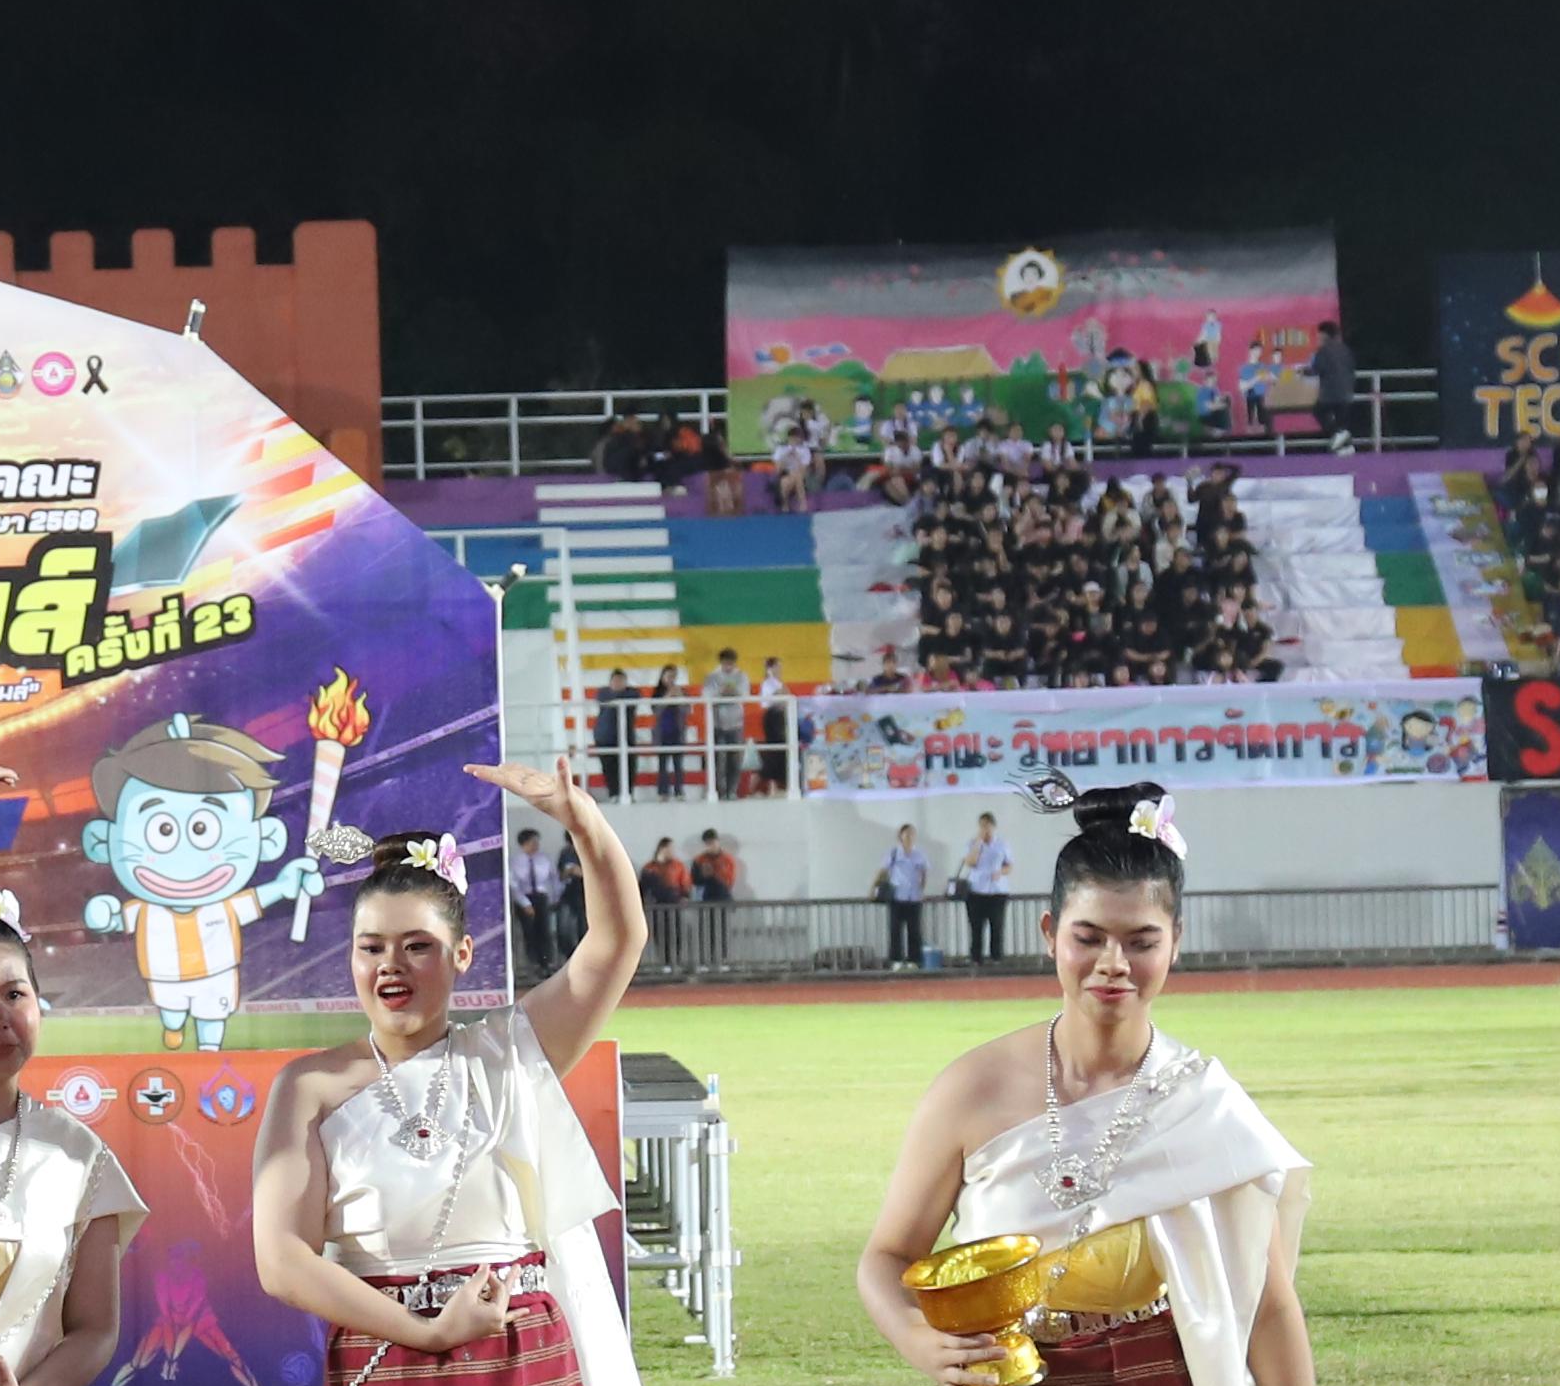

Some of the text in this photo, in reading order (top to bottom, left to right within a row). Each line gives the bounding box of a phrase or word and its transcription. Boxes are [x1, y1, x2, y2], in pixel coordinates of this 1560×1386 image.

[28, 509, 97, 533] 2568
[64, 596, 253, 679] ครั้งที่ 23
